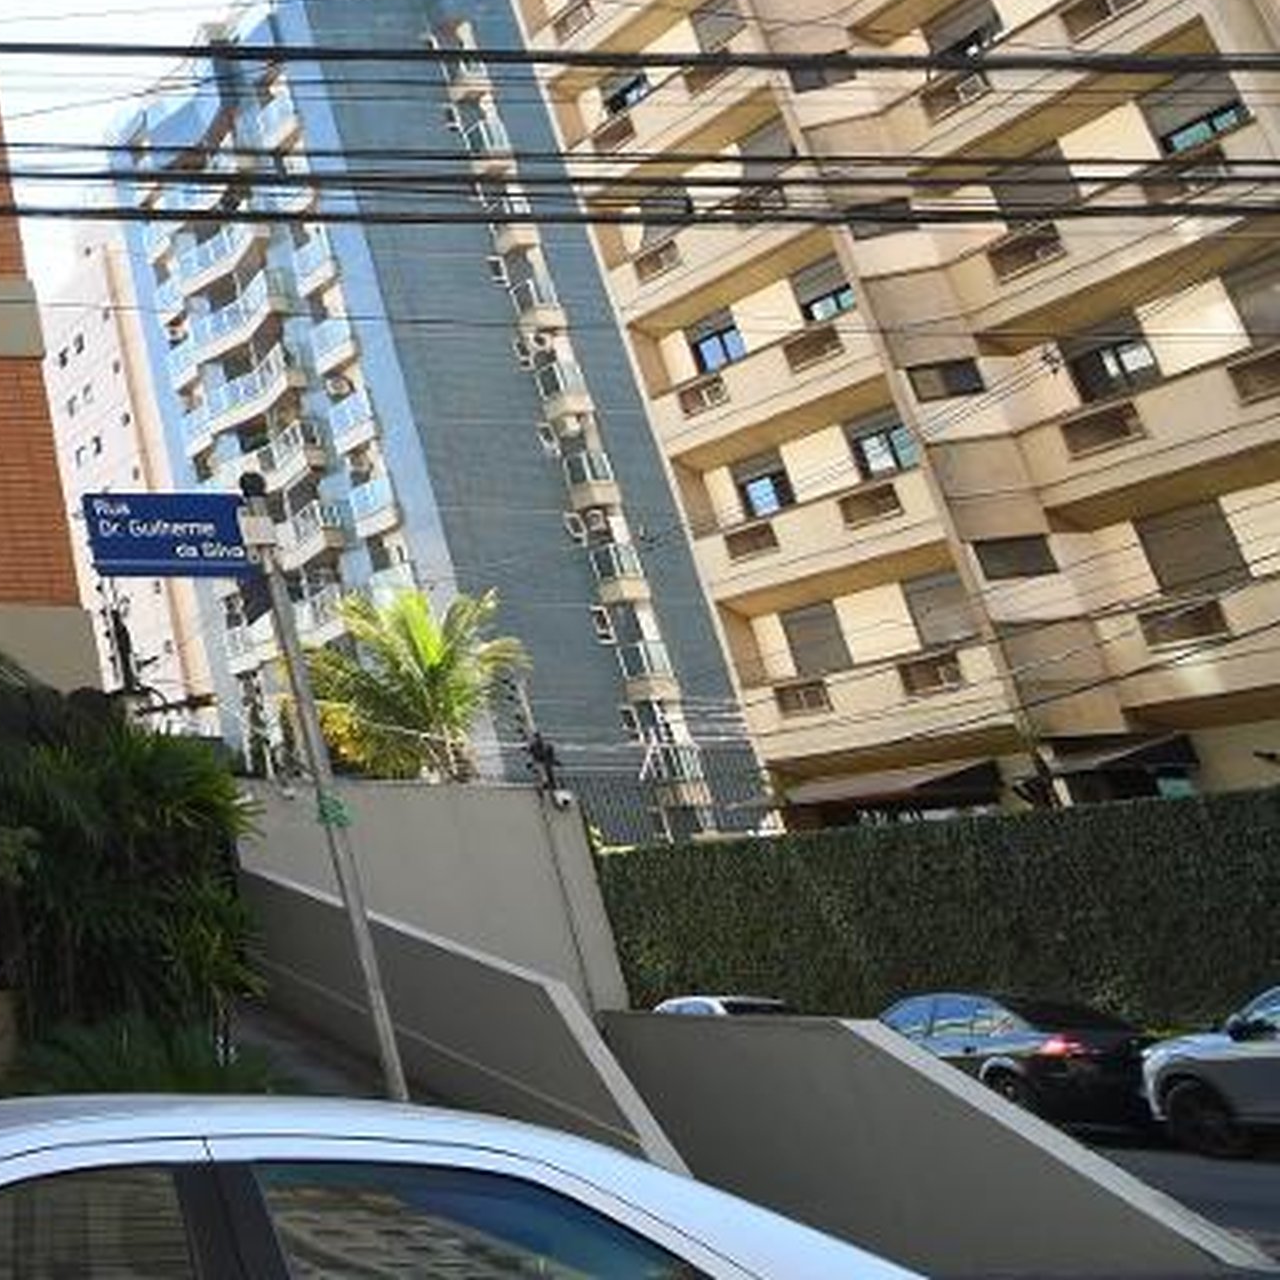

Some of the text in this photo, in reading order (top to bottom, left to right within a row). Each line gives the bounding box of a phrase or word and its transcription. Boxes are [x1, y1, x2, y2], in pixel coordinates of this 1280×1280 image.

[93, 499, 131, 517] Rua
[129, 519, 216, 537] Guilherme
[175, 542, 245, 558] da Silva
